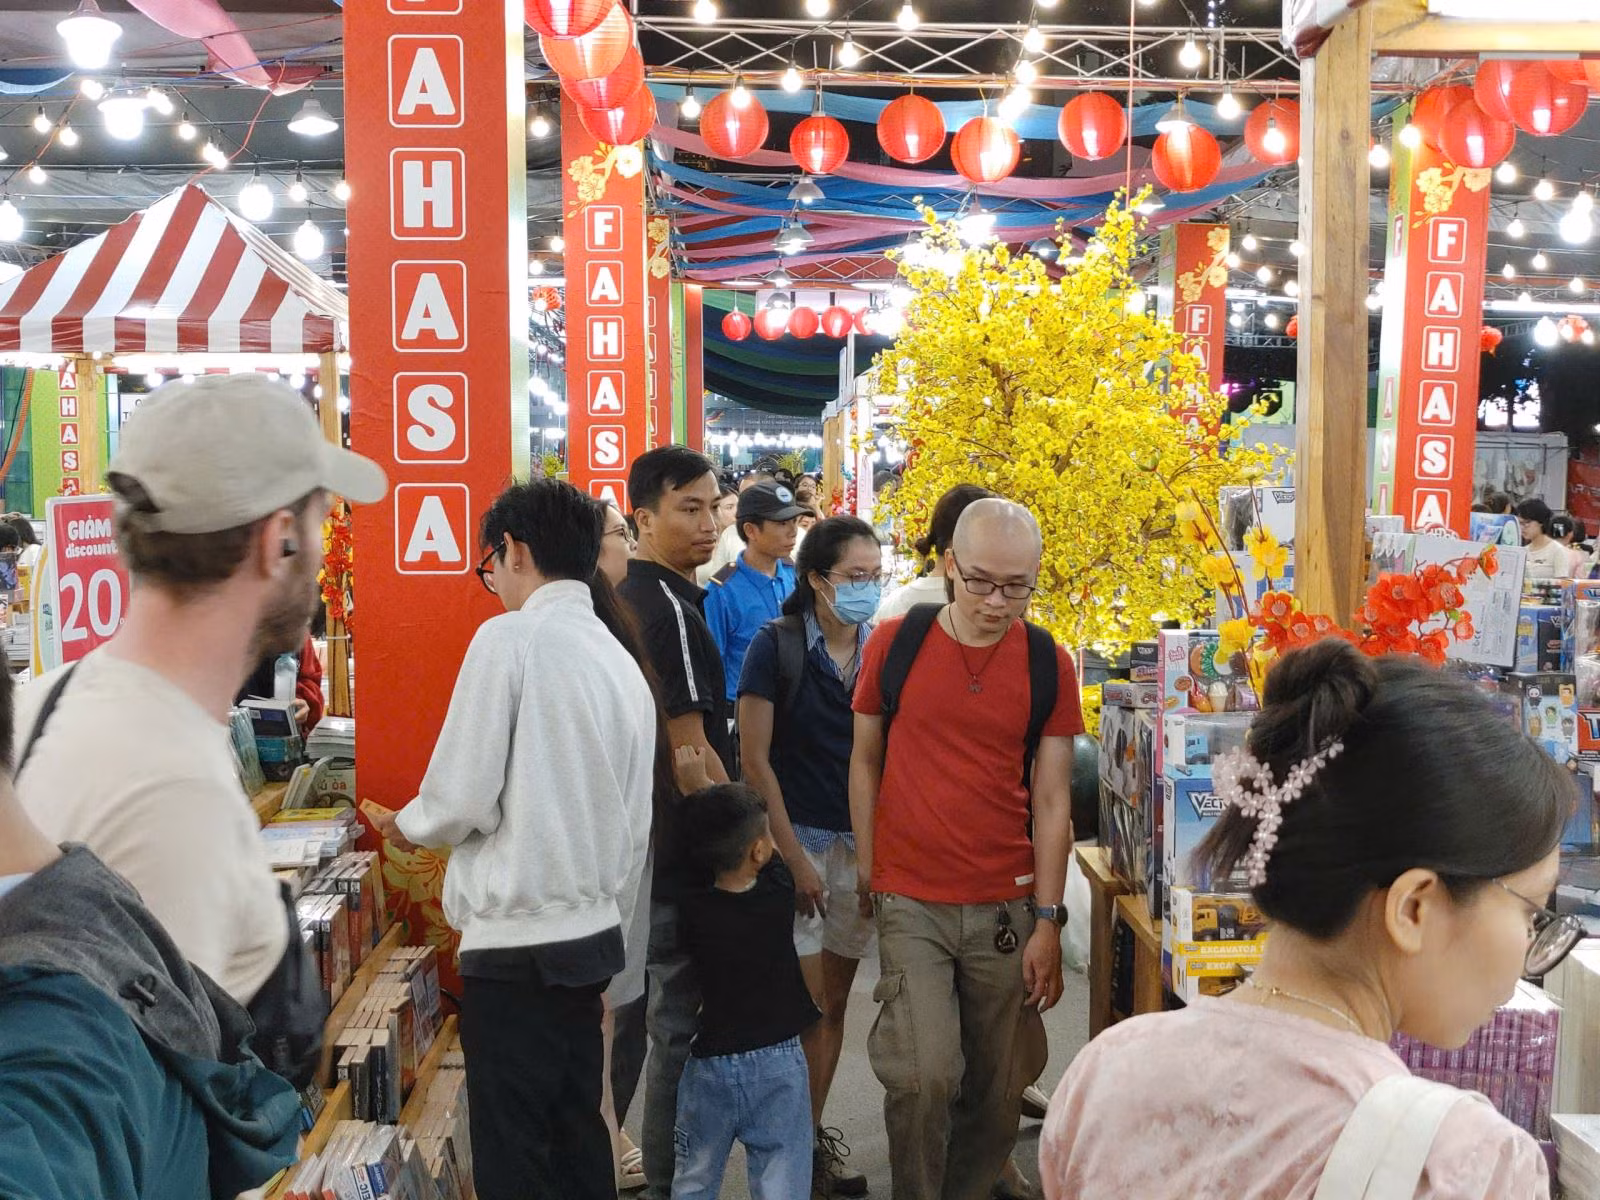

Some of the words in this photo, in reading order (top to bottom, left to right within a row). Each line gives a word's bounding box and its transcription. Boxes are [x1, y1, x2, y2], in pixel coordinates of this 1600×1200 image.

[397, 0, 462, 563] AHASA
[1415, 223, 1459, 529] FAHASA
[59, 568, 126, 643] 20
